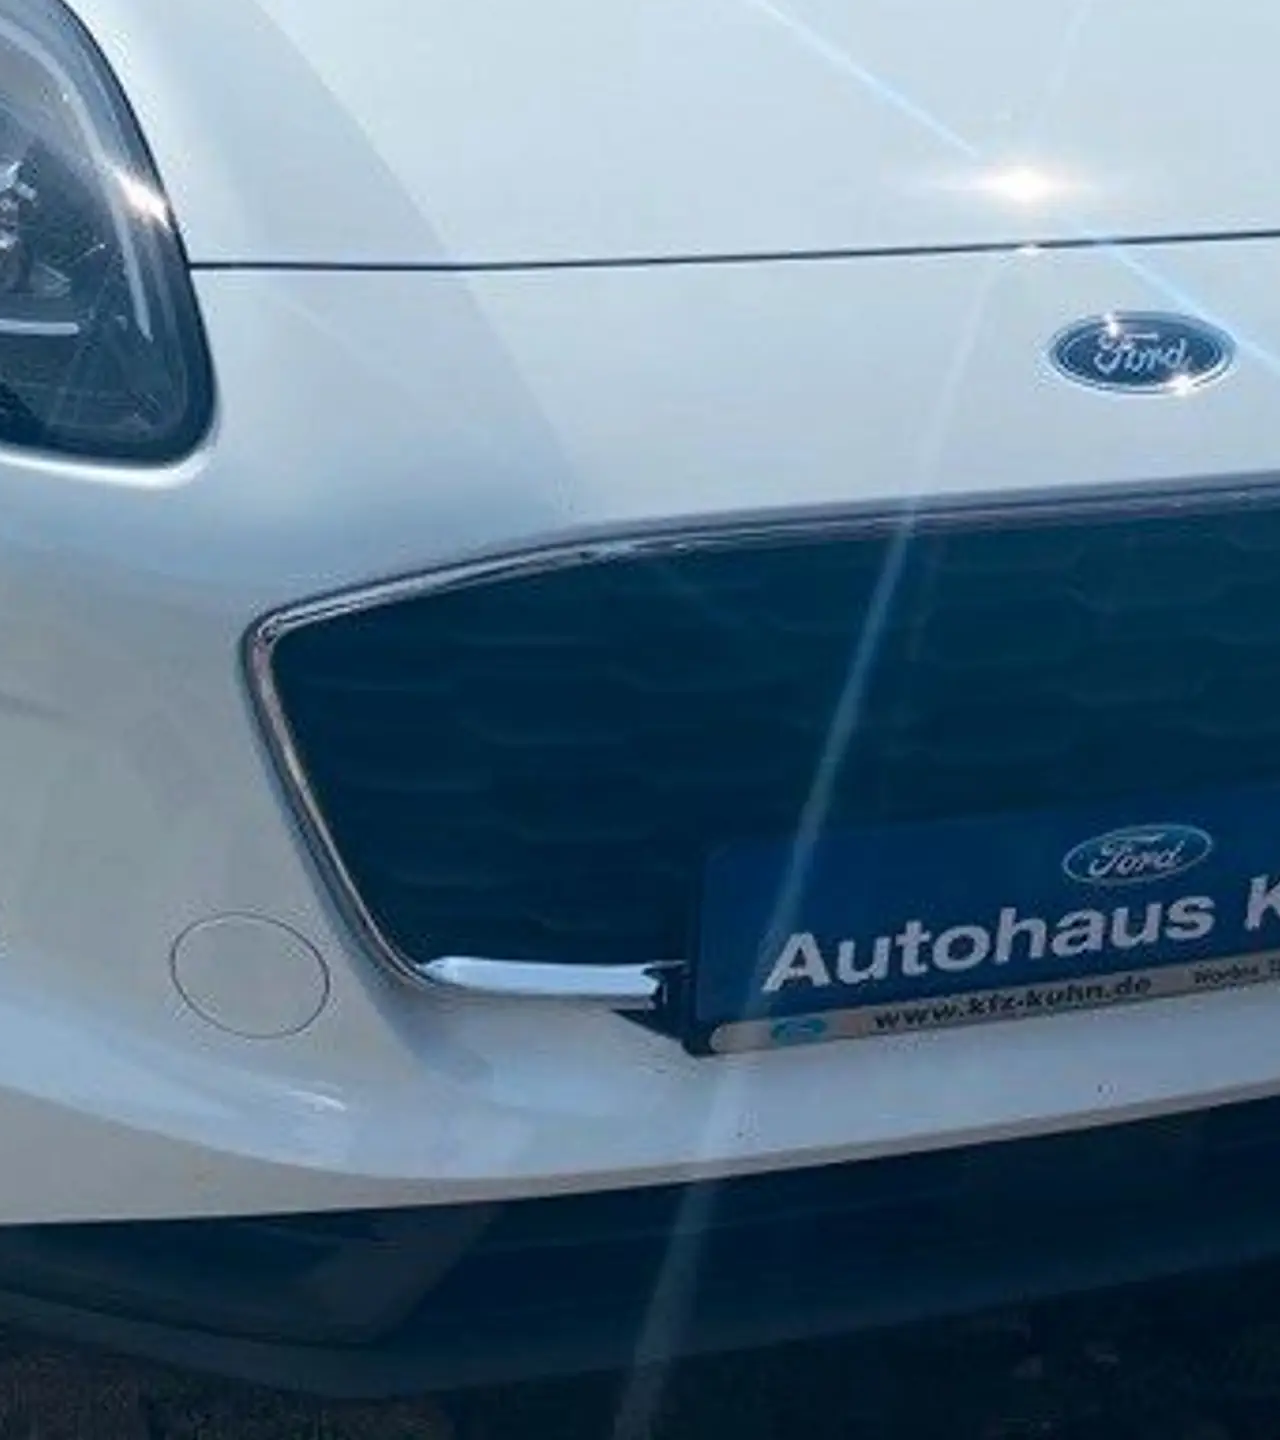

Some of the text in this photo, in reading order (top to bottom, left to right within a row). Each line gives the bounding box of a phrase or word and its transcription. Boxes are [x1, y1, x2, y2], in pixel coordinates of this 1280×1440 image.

[1093, 332, 1192, 375] Ford
[1087, 832, 1186, 876] Ford
[762, 895, 1216, 992] Autohaus
[873, 973, 1152, 1030] www.kfz-kuhn.de
